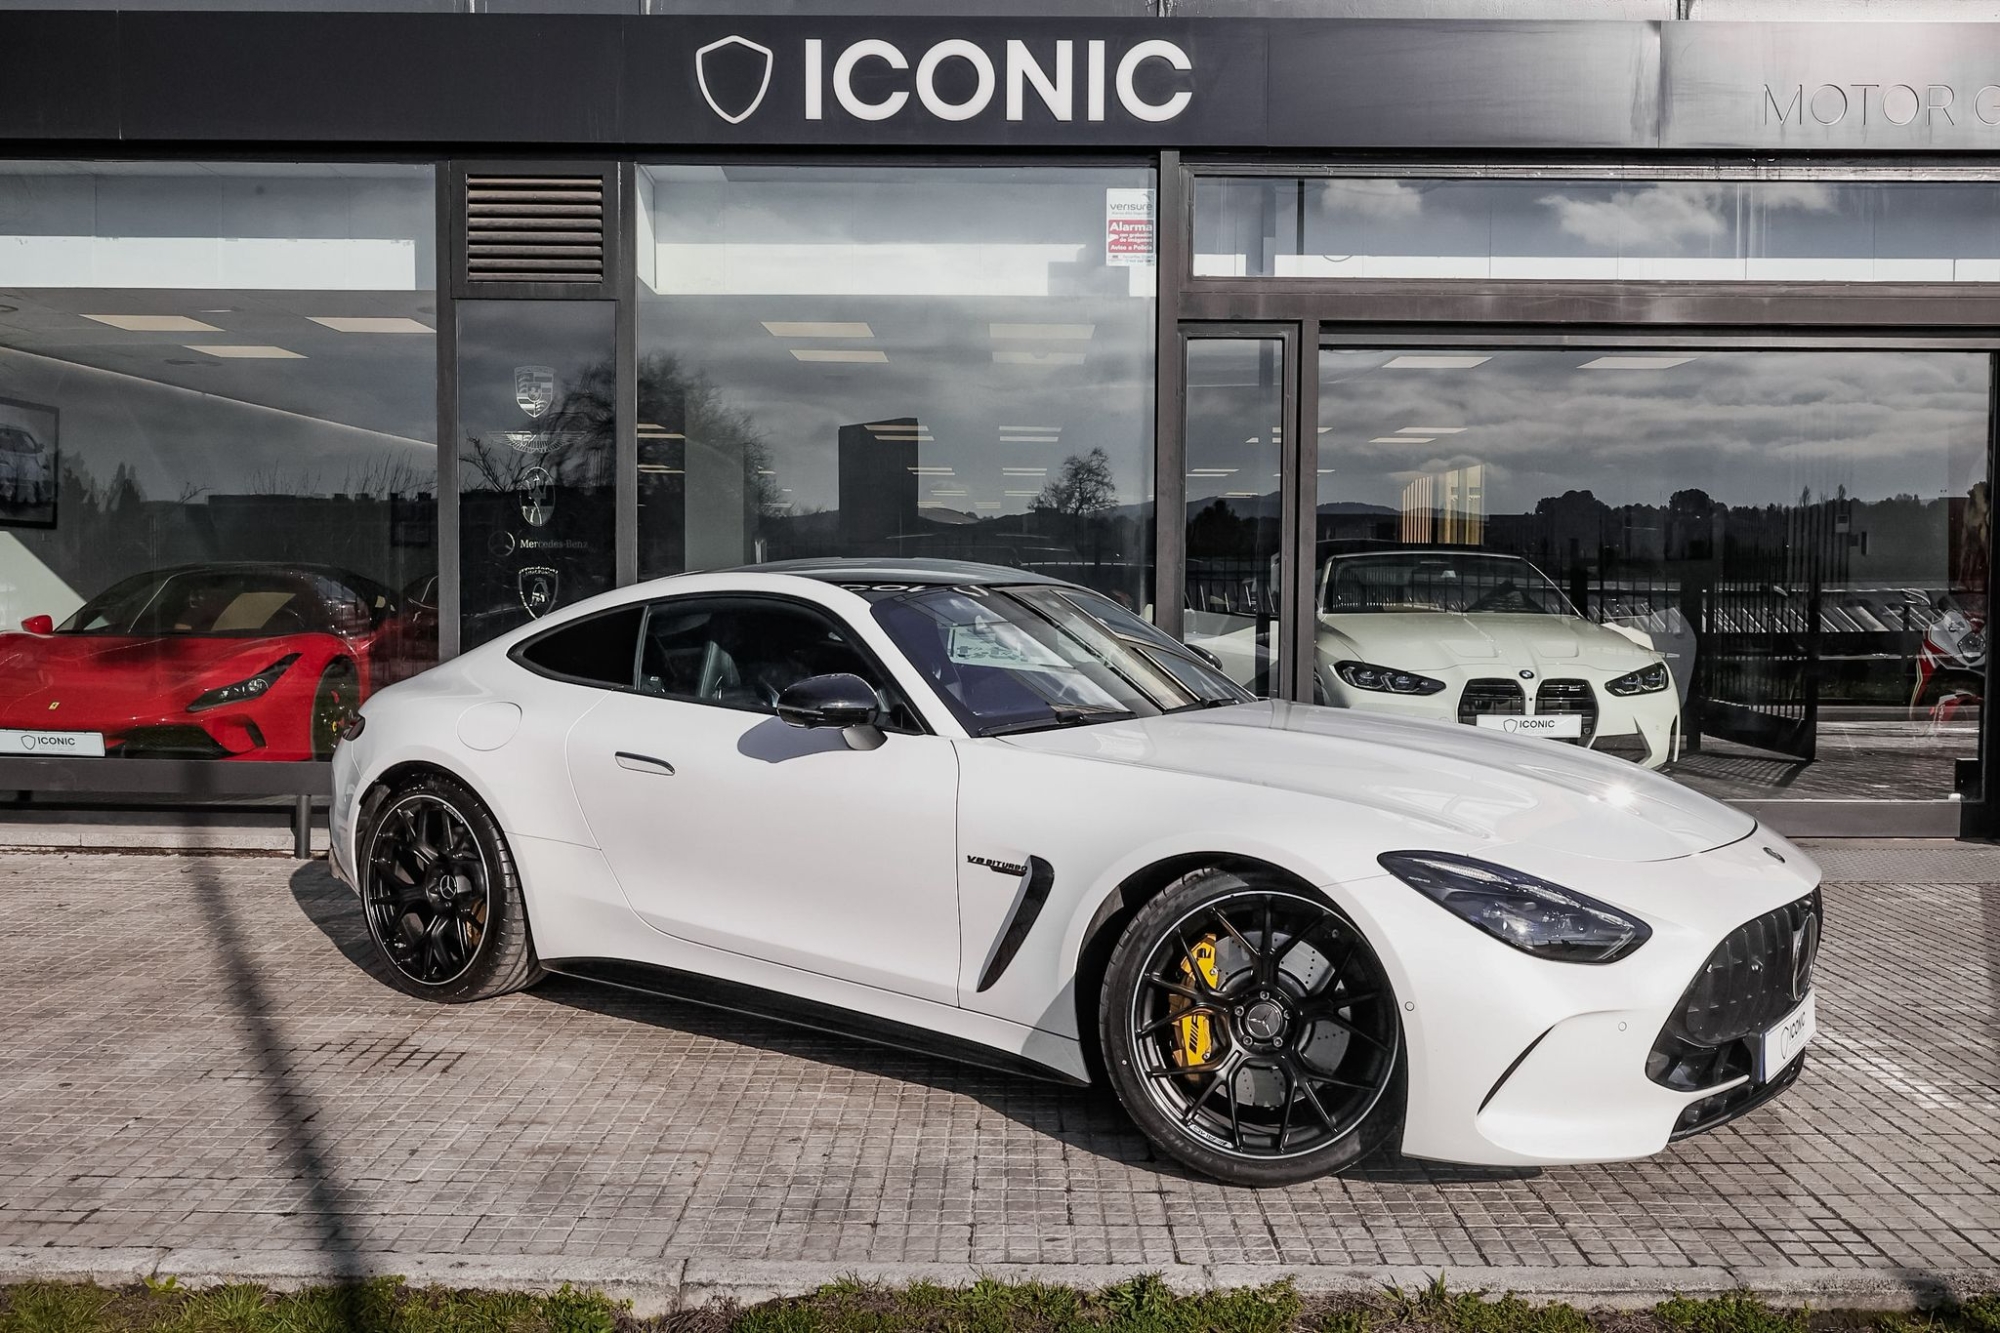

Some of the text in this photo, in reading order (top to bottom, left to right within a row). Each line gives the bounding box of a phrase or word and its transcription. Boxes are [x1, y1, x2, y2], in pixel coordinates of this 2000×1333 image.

[805, 38, 1193, 122] ICONIC
[1763, 83, 1955, 126] MOTOR
[1109, 203, 1153, 211] verisure
[1109, 221, 1153, 231] Alarma
[520, 539, 589, 549] Mercedes-Benz
[1519, 720, 1556, 729] ICONIC
[37, 736, 76, 746] ICONIC
[967, 855, 1028, 872] V8 BITURBO
